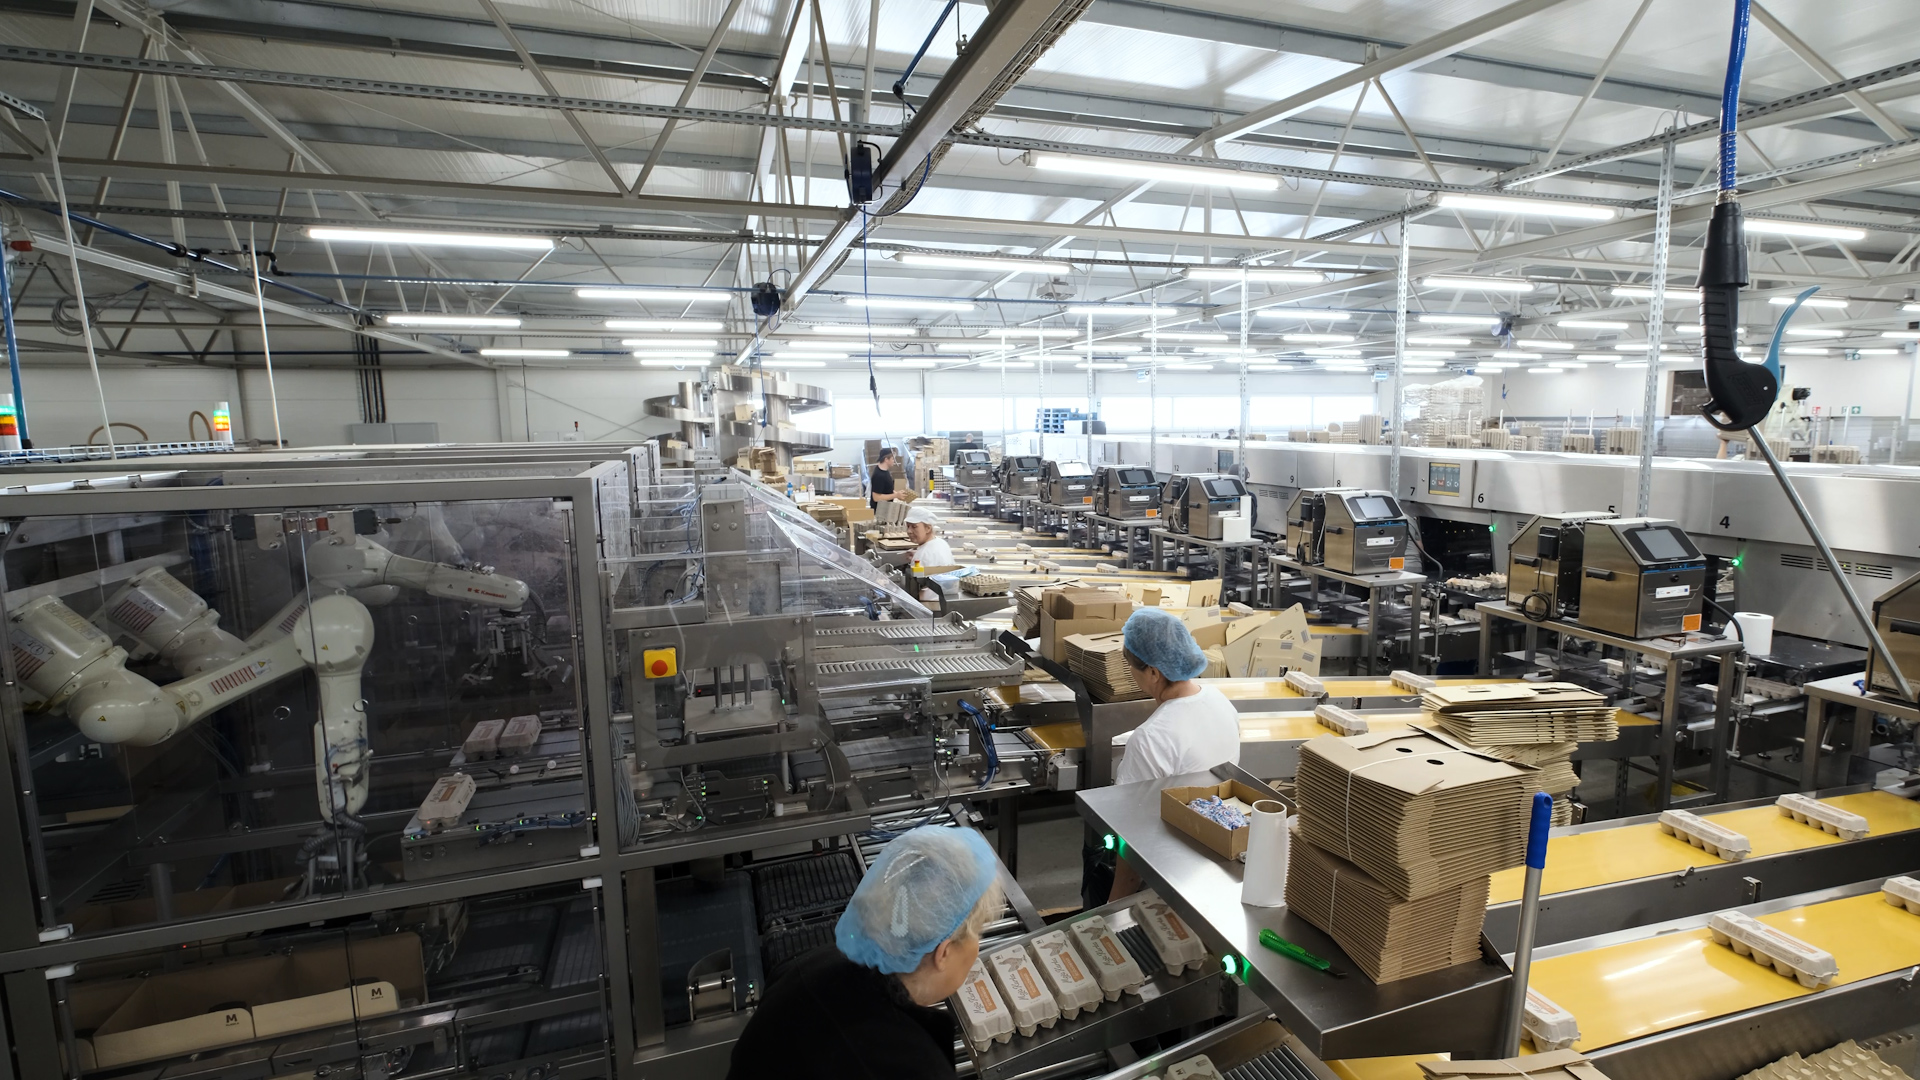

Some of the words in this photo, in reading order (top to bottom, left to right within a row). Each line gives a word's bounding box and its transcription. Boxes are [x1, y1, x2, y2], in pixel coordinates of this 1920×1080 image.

[1290, 475, 1294, 484] 9
[1410, 486, 1416, 496] 7
[1478, 492, 1484, 503] 6
[1608, 505, 1615, 513] 5
[1719, 515, 1731, 529] 4
[372, 988, 382, 996] M
[226, 1014, 238, 1023] M
